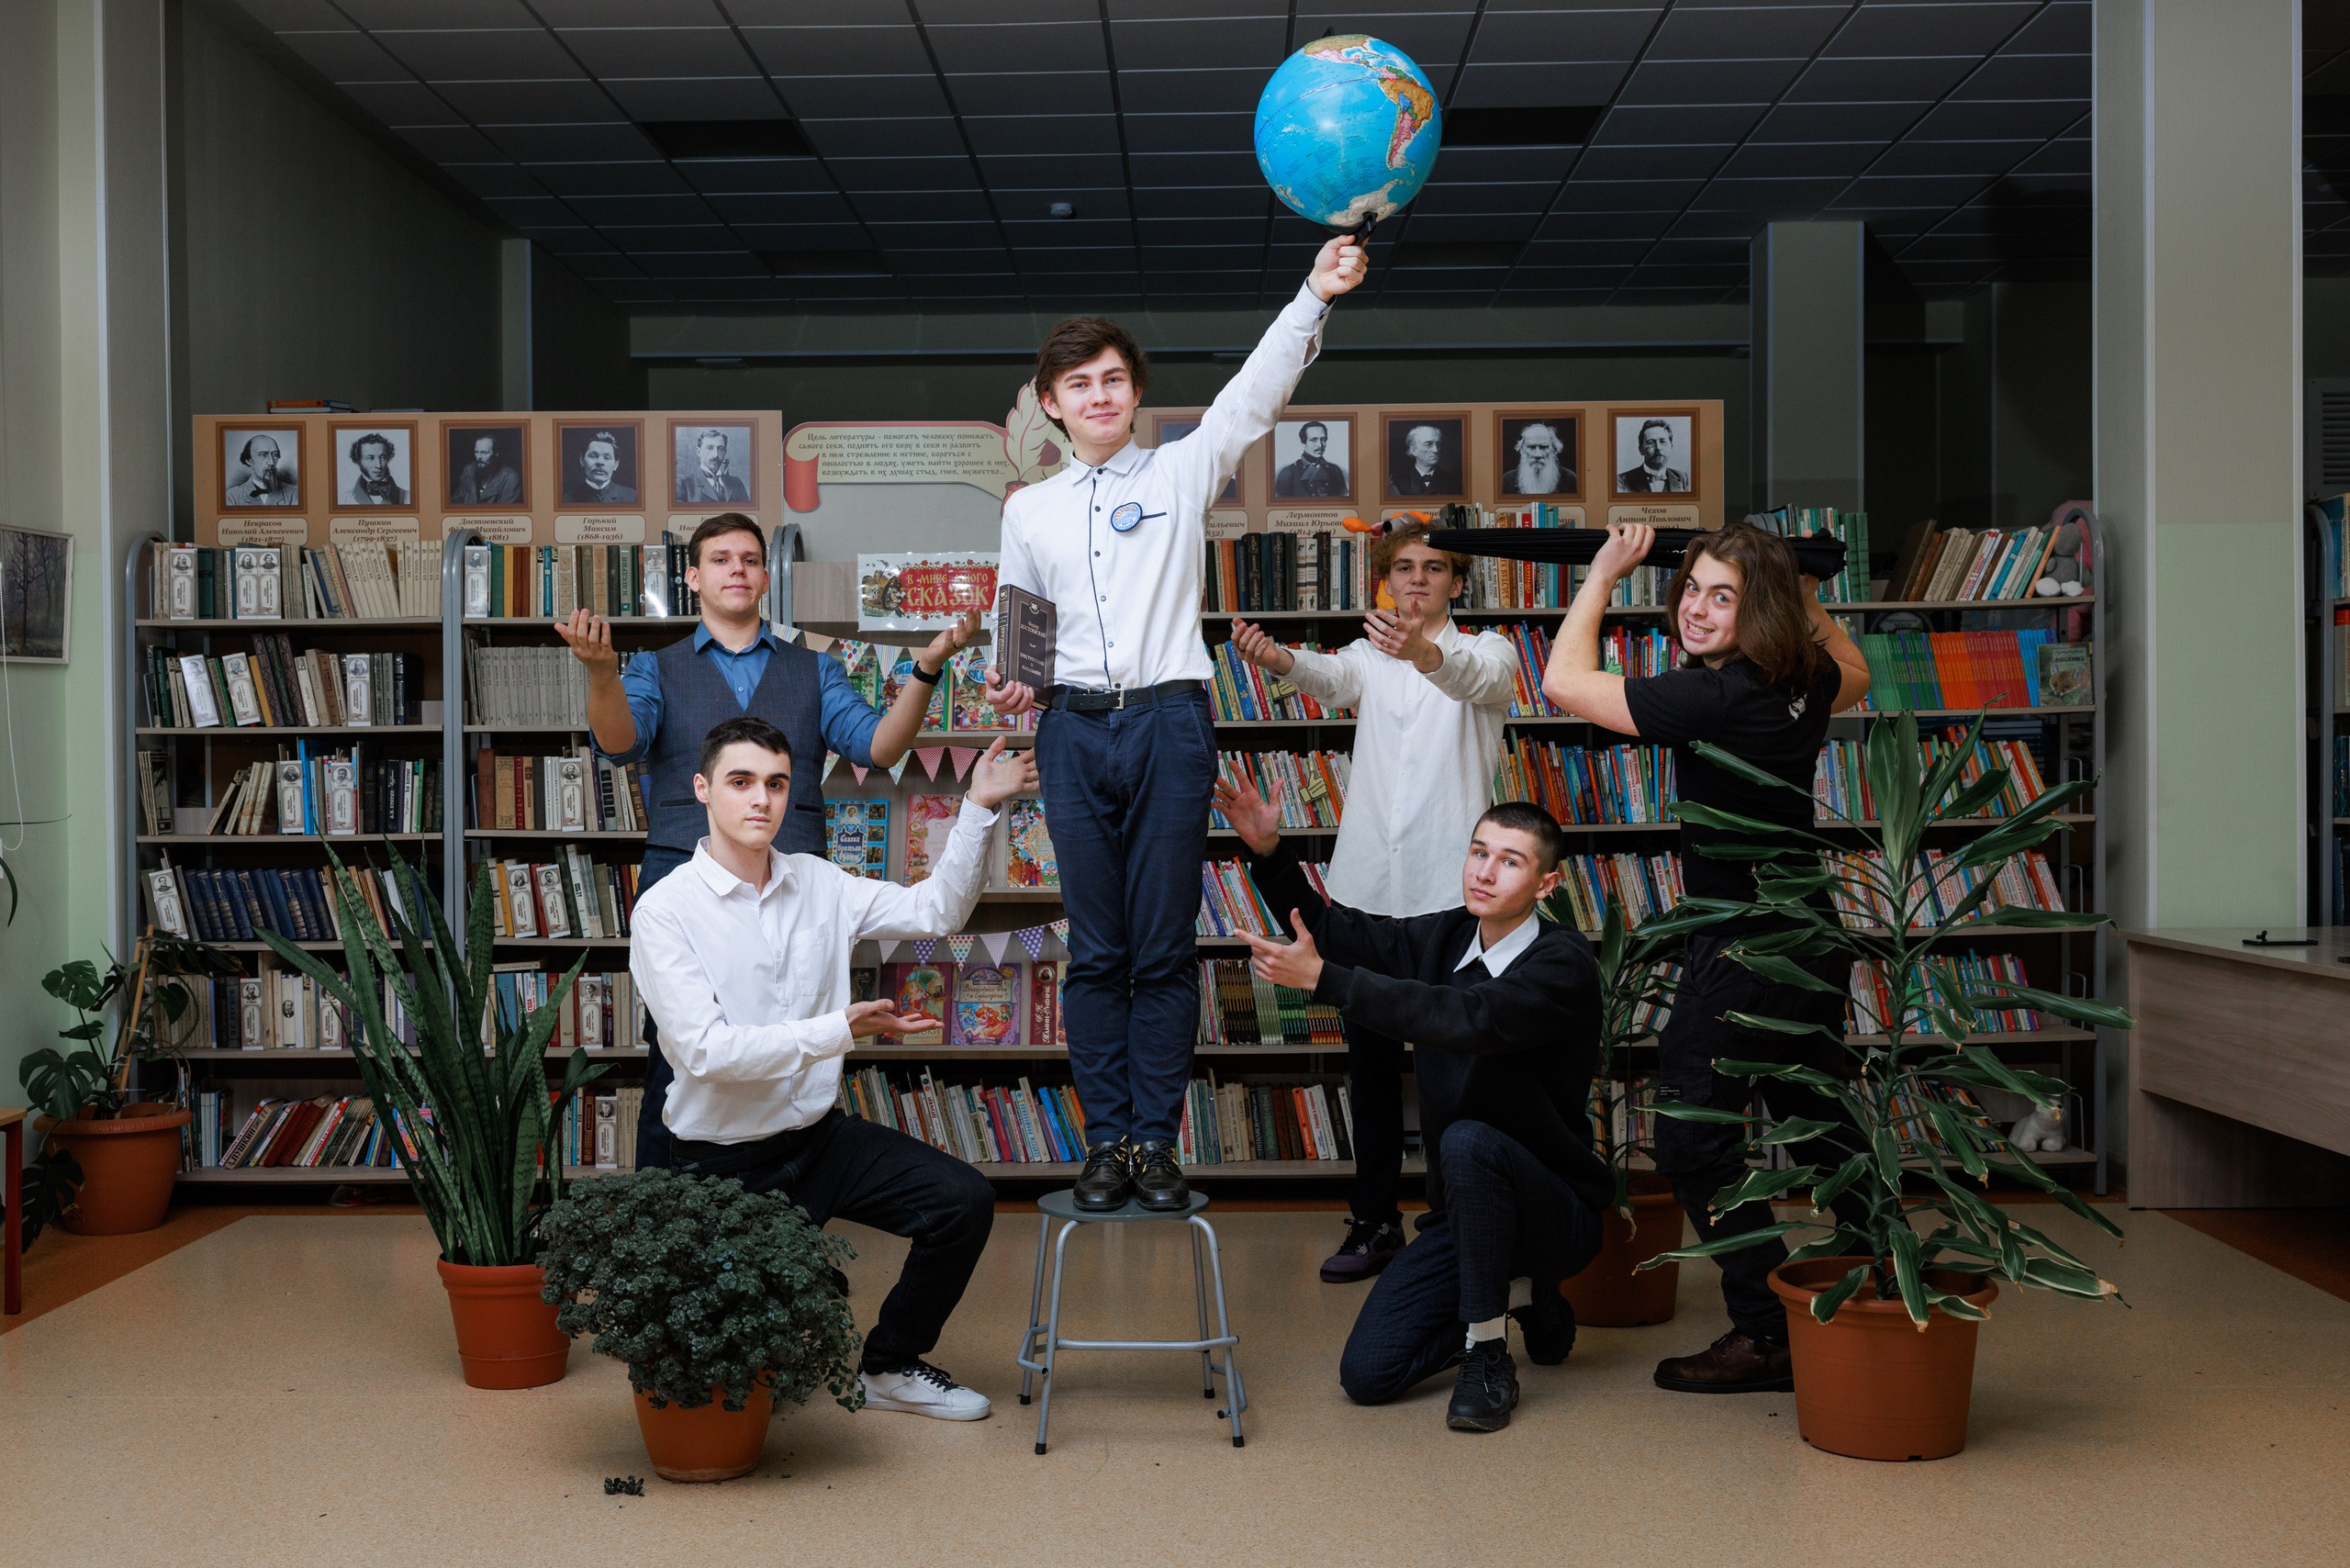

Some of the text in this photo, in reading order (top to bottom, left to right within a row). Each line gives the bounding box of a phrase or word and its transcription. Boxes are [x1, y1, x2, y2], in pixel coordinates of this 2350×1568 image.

[822, 460, 864, 468] пошлостью
[901, 460, 925, 468] уметь
[928, 460, 951, 468] найти
[954, 460, 984, 468] хорошее
[1286, 510, 1338, 520] Лермонтов
[1647, 515, 1691, 523] Павлович
[583, 517, 617, 525] Горький
[1311, 521, 1344, 529] Юрьев
[222, 528, 257, 536] Николай
[332, 527, 375, 535] Александр
[476, 525, 526, 533] Михайлович
[577, 532, 622, 542] (1868-1936)
[907, 585, 990, 607] СКАЗОК
